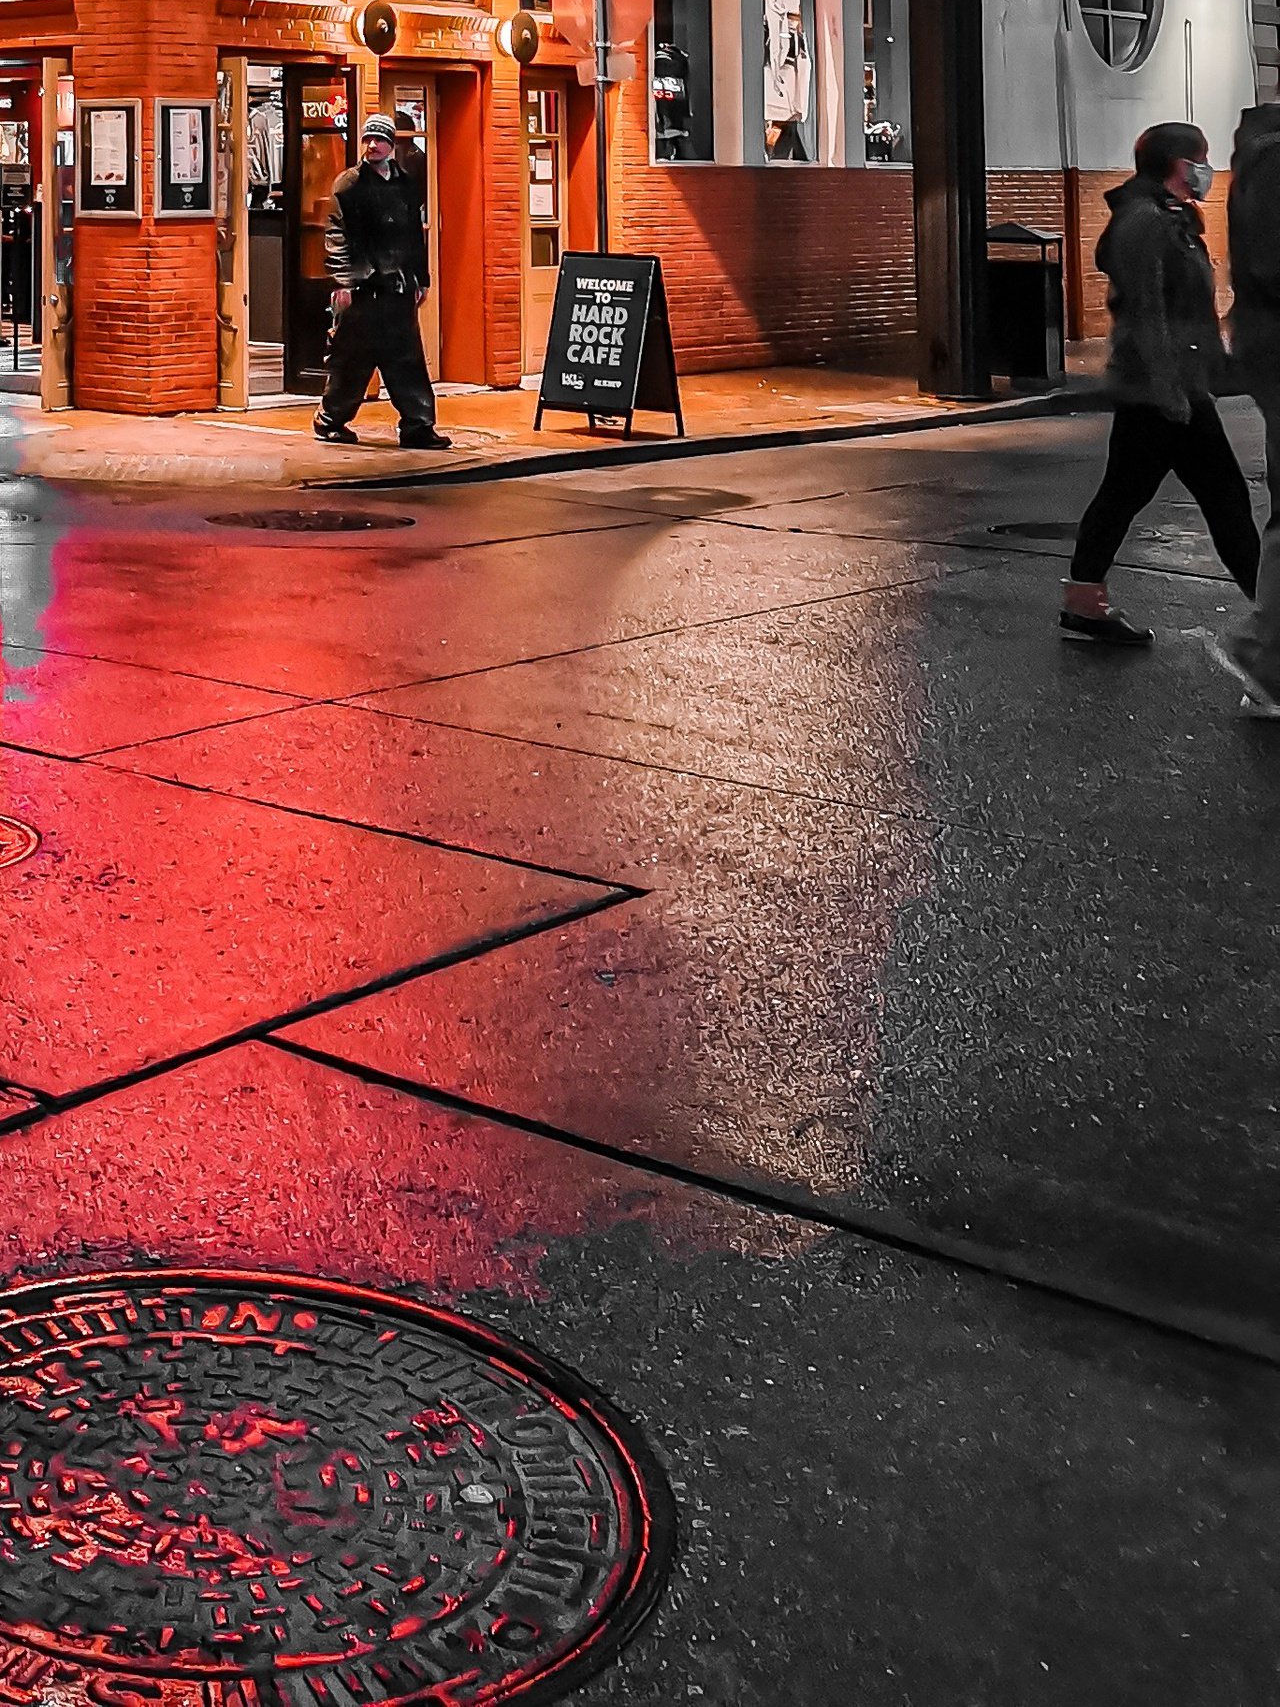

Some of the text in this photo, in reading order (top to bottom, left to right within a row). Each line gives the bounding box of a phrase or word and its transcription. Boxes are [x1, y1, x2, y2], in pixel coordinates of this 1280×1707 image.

[576, 277, 634, 292] WELCOME
[594, 292, 611, 304] TO
[571, 304, 628, 325] HARD
[569, 323, 625, 346] ROCK
[566, 344, 622, 366] CAFE
